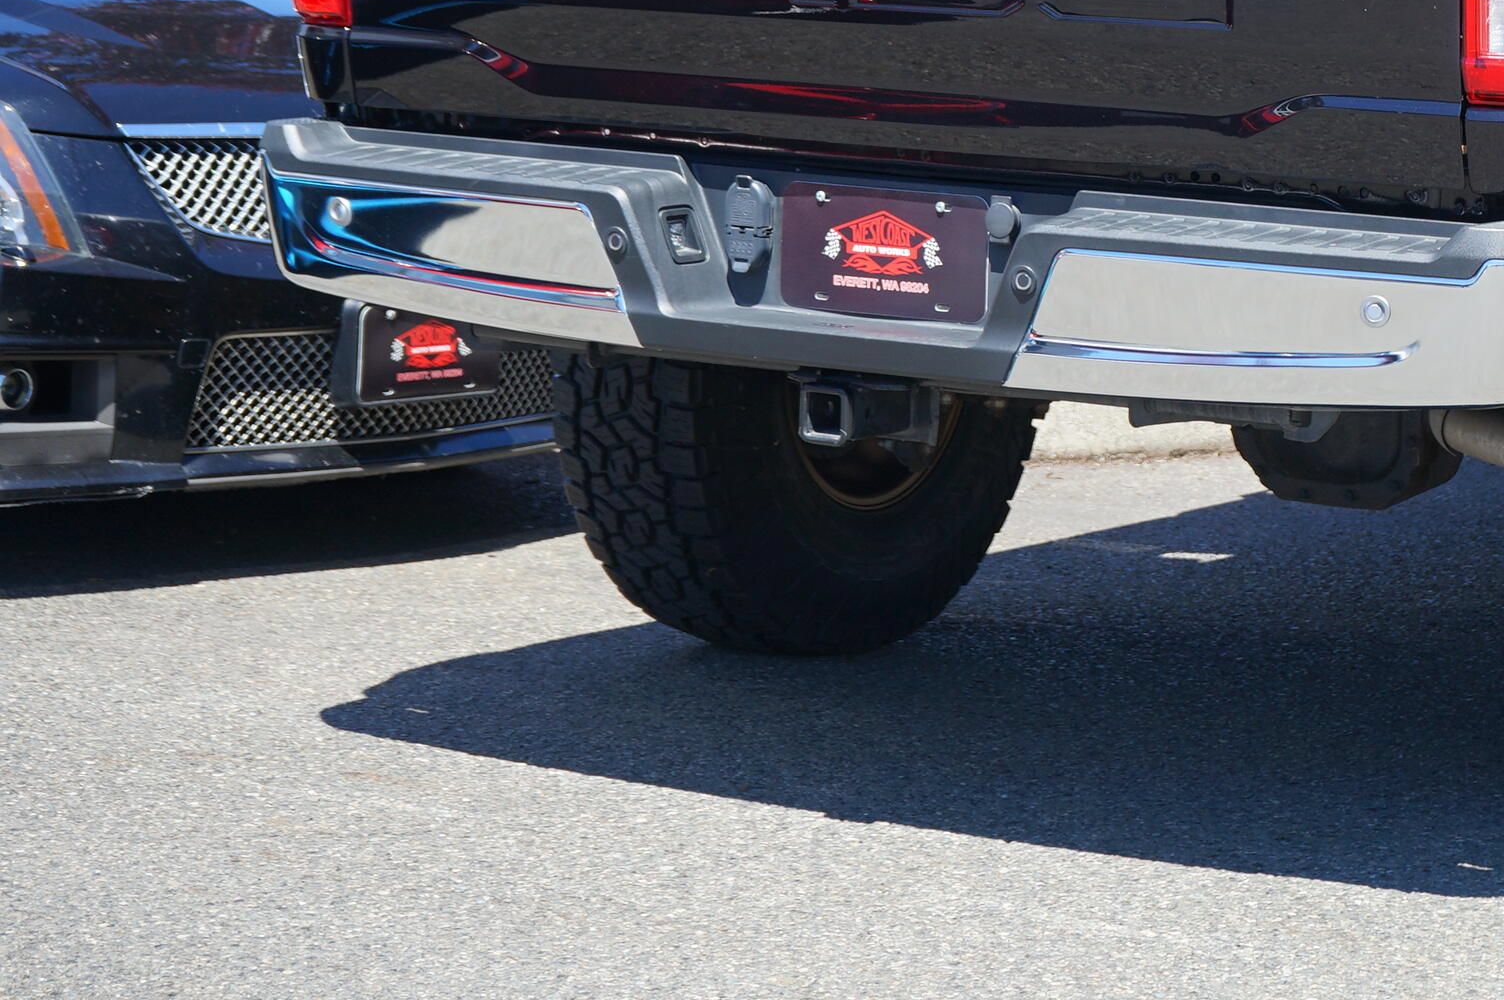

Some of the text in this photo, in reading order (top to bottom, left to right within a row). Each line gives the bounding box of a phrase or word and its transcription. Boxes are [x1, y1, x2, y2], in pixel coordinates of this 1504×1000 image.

[852, 244, 911, 257] AUTO WORKS
[881, 279, 900, 292] WA
